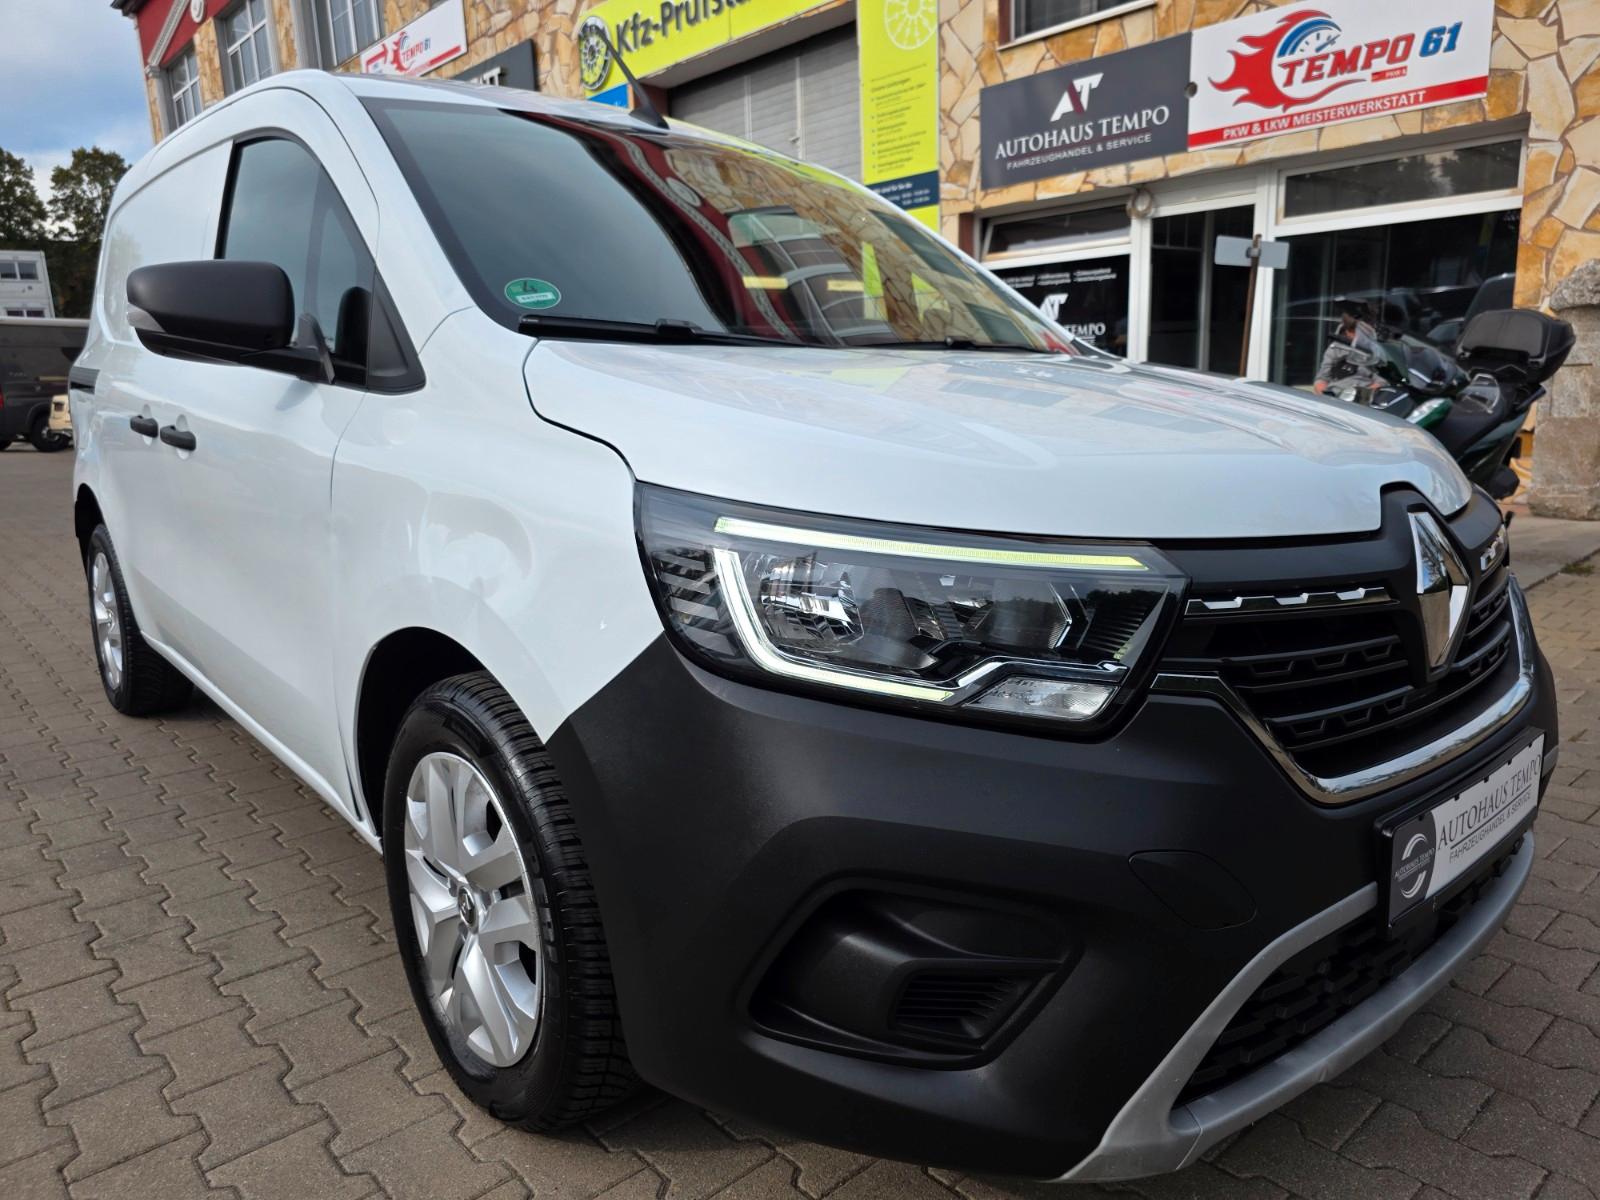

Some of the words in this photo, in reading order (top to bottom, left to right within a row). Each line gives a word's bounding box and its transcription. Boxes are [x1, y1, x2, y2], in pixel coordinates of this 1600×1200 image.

[1278, 33, 1415, 88] TEMPO
[1419, 21, 1463, 58] 61
[995, 122, 1094, 160] AUTOHAUS
[1098, 105, 1170, 138] TEMPO
[1223, 126, 1249, 139] PKW
[1252, 123, 1261, 134] &
[1264, 118, 1289, 132] LKW
[1292, 90, 1427, 127] MEISTERWERKSTATT
[1007, 146, 1092, 171] FAHRZEUGHANDEL
[1096, 143, 1103, 152] &
[1106, 133, 1152, 150] SERVICE
[1438, 780, 1509, 851] AUTOHAUS
[1510, 754, 1542, 796] TEMPO
[1449, 815, 1506, 864] FAHRZEUGHANDEL
[1511, 791, 1532, 816] SERVICE
